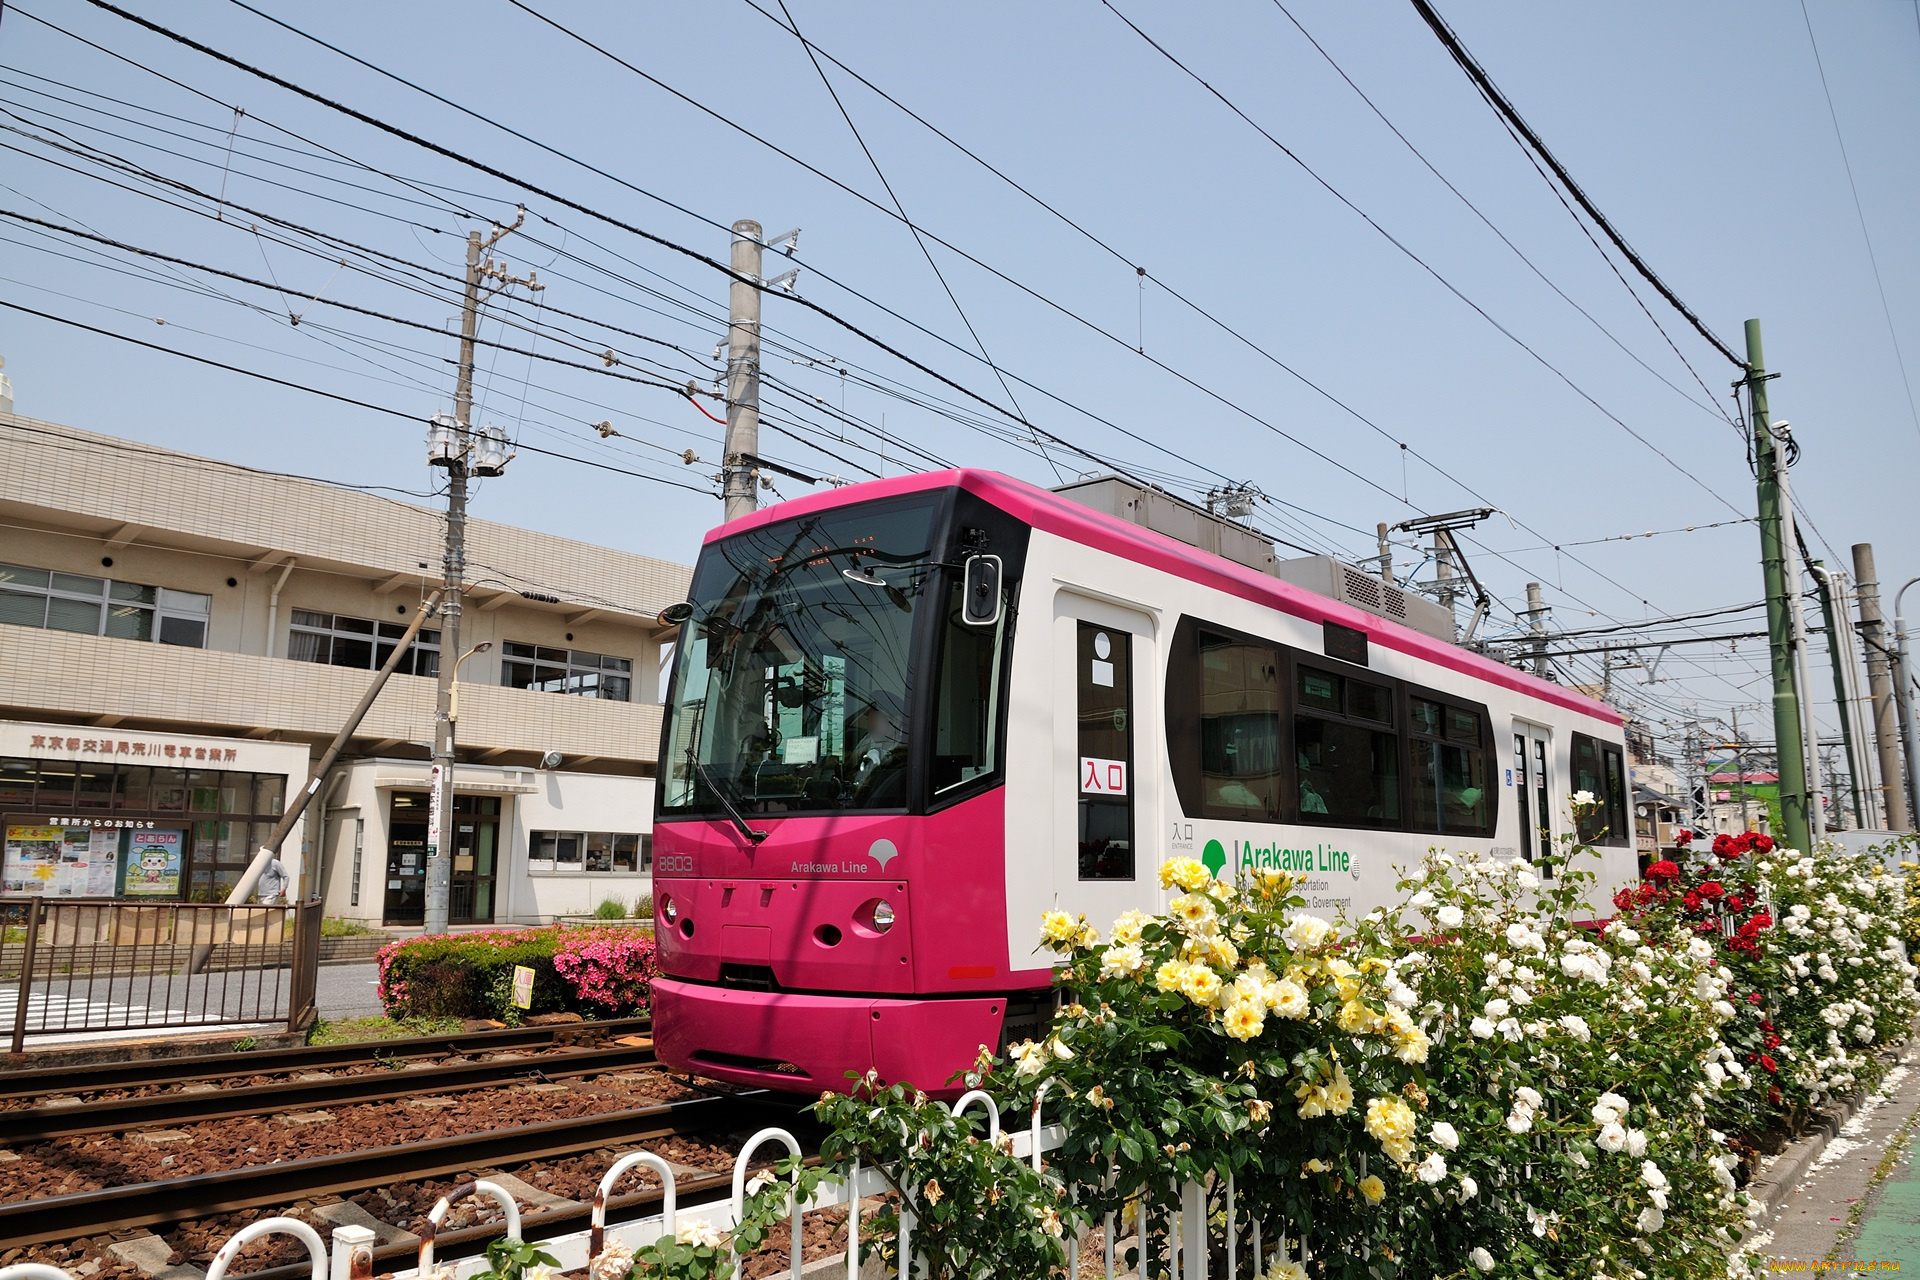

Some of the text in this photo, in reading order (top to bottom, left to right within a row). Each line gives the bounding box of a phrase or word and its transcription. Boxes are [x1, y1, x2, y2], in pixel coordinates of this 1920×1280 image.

[30, 734, 237, 762] 東京都交通局荒川電車営業所
[1084, 761, 1123, 791] 入口
[49, 817, 155, 829] 営業所からのお知らせ
[135, 834, 177, 843] とあらん
[1172, 823, 1193, 841] 入口
[1172, 842, 1193, 850] ENTRANCE
[658, 856, 693, 872] 8803
[1242, 840, 1350, 872] Arakawa Line
[791, 861, 868, 873] Arakawa Line
[1312, 896, 1352, 909] Government
[515, 968, 534, 987] 入庫
